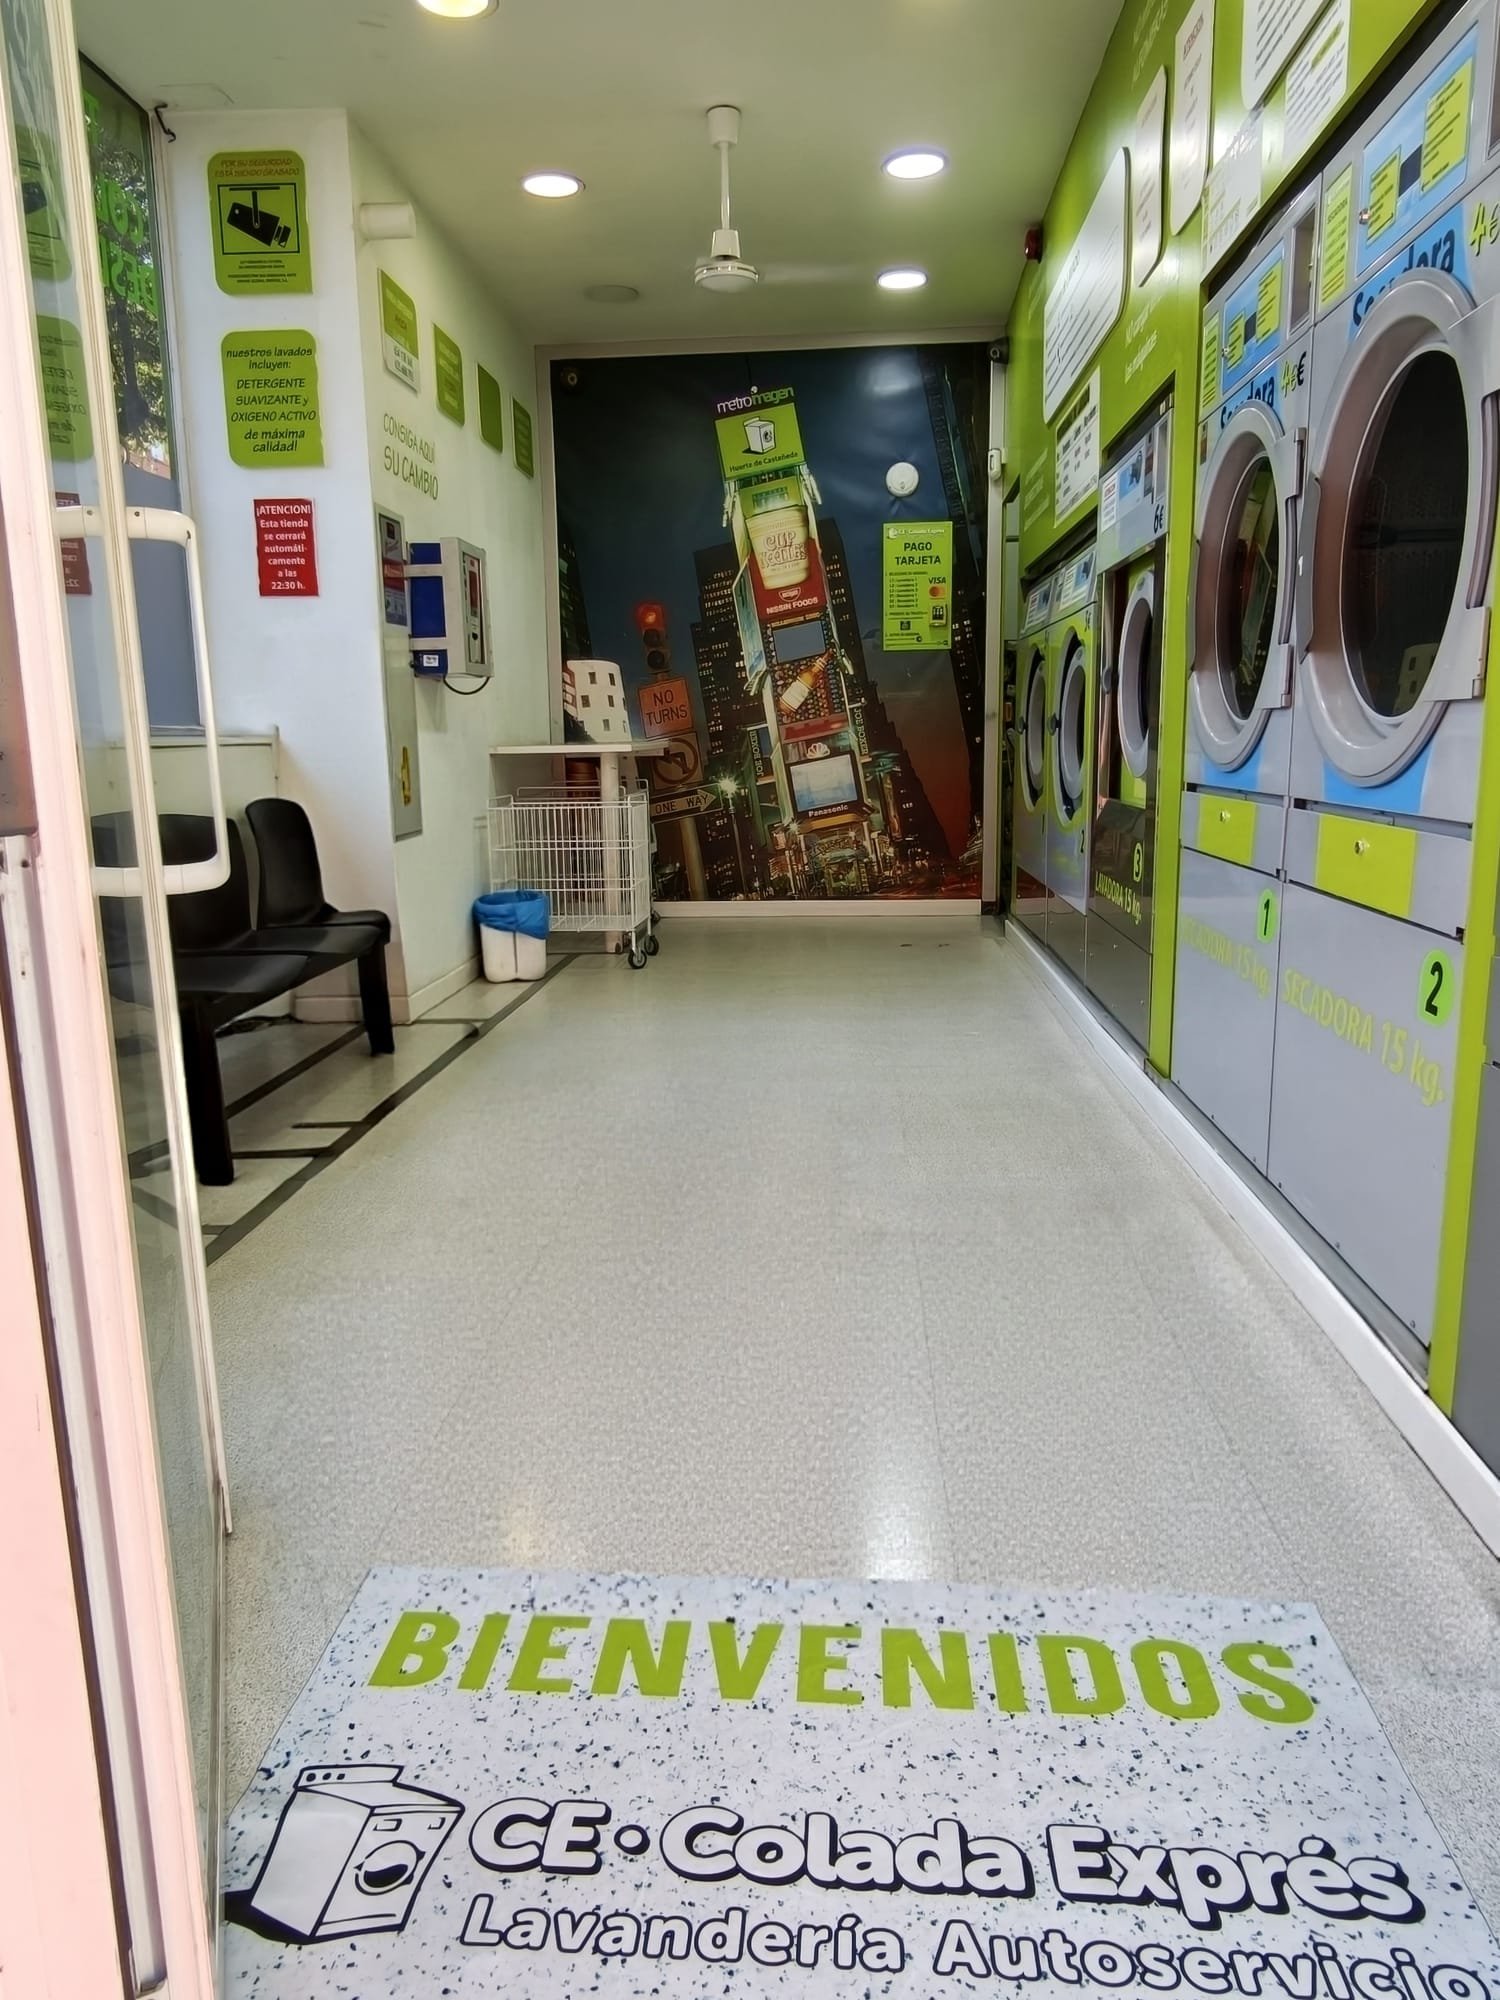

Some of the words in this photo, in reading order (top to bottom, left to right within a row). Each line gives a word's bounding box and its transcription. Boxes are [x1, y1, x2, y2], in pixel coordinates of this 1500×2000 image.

[1353, 229, 1455, 326] Sdora
[226, 349, 272, 358] nuestros
[274, 346, 312, 356] lavados
[249, 360, 291, 371] incluyen:
[236, 378, 305, 389] DETERGENTE
[235, 395, 301, 406] SUAVIZANTE
[717, 386, 794, 413] metroimagen
[1221, 376, 1275, 430] Sdora
[231, 411, 277, 422] OXIGENO
[279, 411, 316, 421] ACTIVO
[244, 429, 258, 440] de
[261, 428, 305, 439] máxima
[383, 413, 418, 454] CONSIGA
[252, 440, 298, 452] calidad!
[384, 445, 400, 476] SU
[401, 456, 439, 500] CAMBIO
[260, 520, 279, 528] Esta
[280, 519, 309, 528] tienda
[264, 532, 274, 540] se
[275, 531, 307, 540] cerrará
[903, 542, 933, 551] PAGO
[894, 555, 942, 566] TARJETA
[284, 568, 297, 577] las
[271, 581, 296, 589] 22:30
[928, 576, 946, 584] VISA
[792, 596, 818, 608] FOODS
[653, 690, 674, 705] NO
[646, 704, 688, 725] TURNS
[655, 801, 676, 814] ONE
[686, 794, 708, 808] WAY
[808, 804, 849, 817] Panasonic
[1095, 870, 1123, 908] LAVADORA
[1124, 887, 1132, 914] 15
[1263, 898, 1271, 937] 1
[1425, 961, 1444, 1017] 2
[1284, 968, 1373, 1054] SECADORA
[1381, 1021, 1408, 1074] 15
[1410, 1039, 1446, 1107] kg.
[366, 1610, 1316, 1724] BIENVENIDOS
[659, 1804, 1036, 1900] Colada
[1046, 1822, 1426, 1932] Exprés
[459, 1892, 906, 1973] Lavandería
[932, 1919, 1496, 2000] Autoservicio
